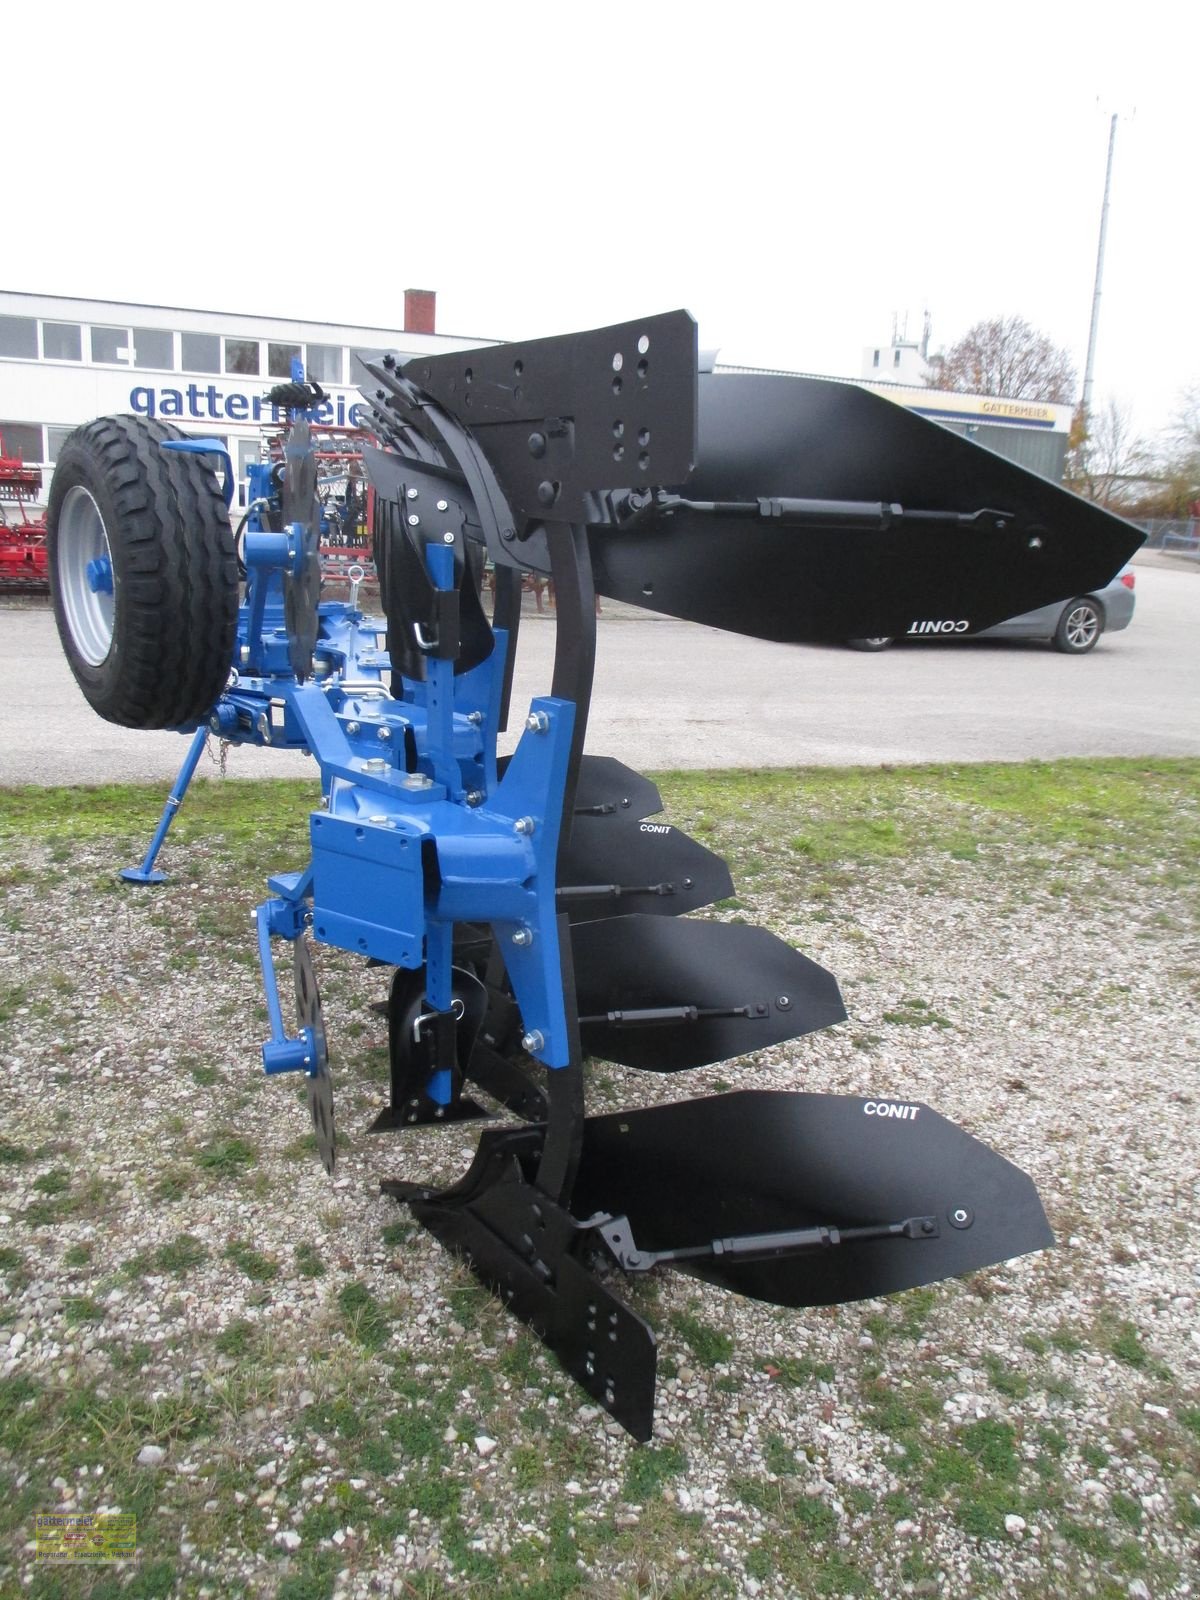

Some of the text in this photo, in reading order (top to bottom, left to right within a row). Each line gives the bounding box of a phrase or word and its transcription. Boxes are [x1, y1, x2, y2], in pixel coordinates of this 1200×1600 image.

[129, 383, 370, 428] gattereie
[983, 402, 1049, 418] GATTERMEIER
[906, 620, 969, 634] CONIT
[639, 823, 672, 834] CONIT
[863, 1101, 920, 1120] CONIT
